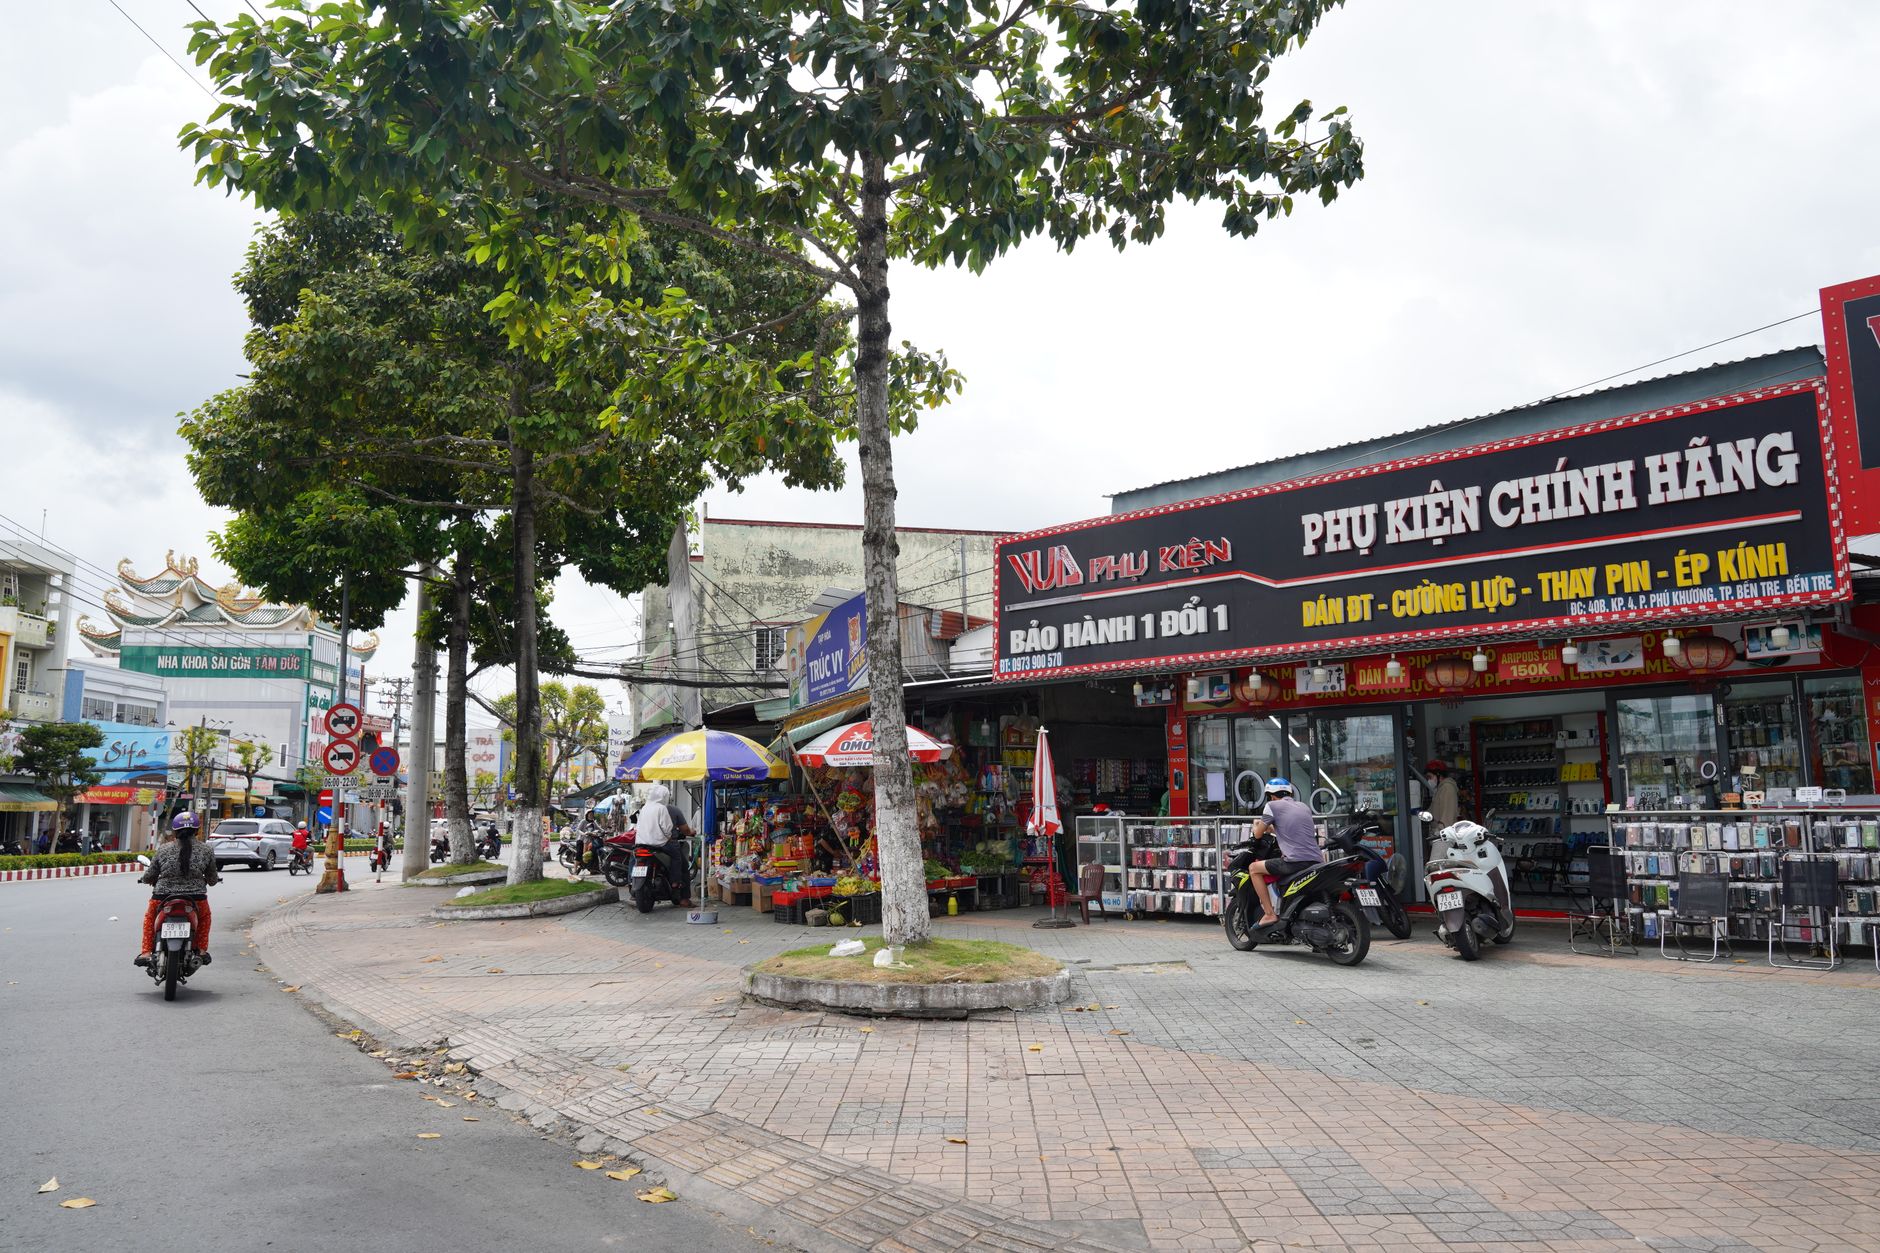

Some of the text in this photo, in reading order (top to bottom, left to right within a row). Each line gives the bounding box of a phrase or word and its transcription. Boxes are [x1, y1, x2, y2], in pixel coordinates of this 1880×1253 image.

[1302, 431, 1800, 556] PHỤ KIỆN CHÍNH HÃNG
[1007, 536, 1233, 594] VUA PHỤ KIỆN
[1302, 593, 1345, 628] DÁN
[1347, 593, 1374, 623] ĐT
[1391, 579, 1467, 618] CƯỜNG
[1471, 575, 1517, 613] LỰC
[1537, 566, 1597, 602] THAY
[1605, 560, 1653, 595] PIN
[1674, 549, 1711, 587] ÉP
[1717, 541, 1790, 583] KÍNH
[1649, 590, 1670, 608] PHÚ
[1736, 580, 1758, 600] BẾN
[1786, 574, 1809, 594] BẾN
[1811, 574, 1833, 591] TRE
[1010, 595, 1229, 655] BẢO HÀNH 1 ĐỔI 1
[157, 652, 300, 672] NHA KHOA SÀI GÒN TÂM ĐỨC
[809, 648, 844, 683] TRÚC VY
[1012, 655, 1030, 672] 0973
[1031, 653, 1046, 669] 900
[1047, 651, 1062, 668] 570
[1501, 652, 1541, 665] ARIPODS
[1510, 661, 1550, 677] 150K
[1359, 665, 1381, 686] DÁN
[475, 734, 495, 747] TRẢ
[840, 740, 873, 752] OMO
[472, 751, 495, 763] GÓP
[1640, 791, 1662, 799] OPEN
